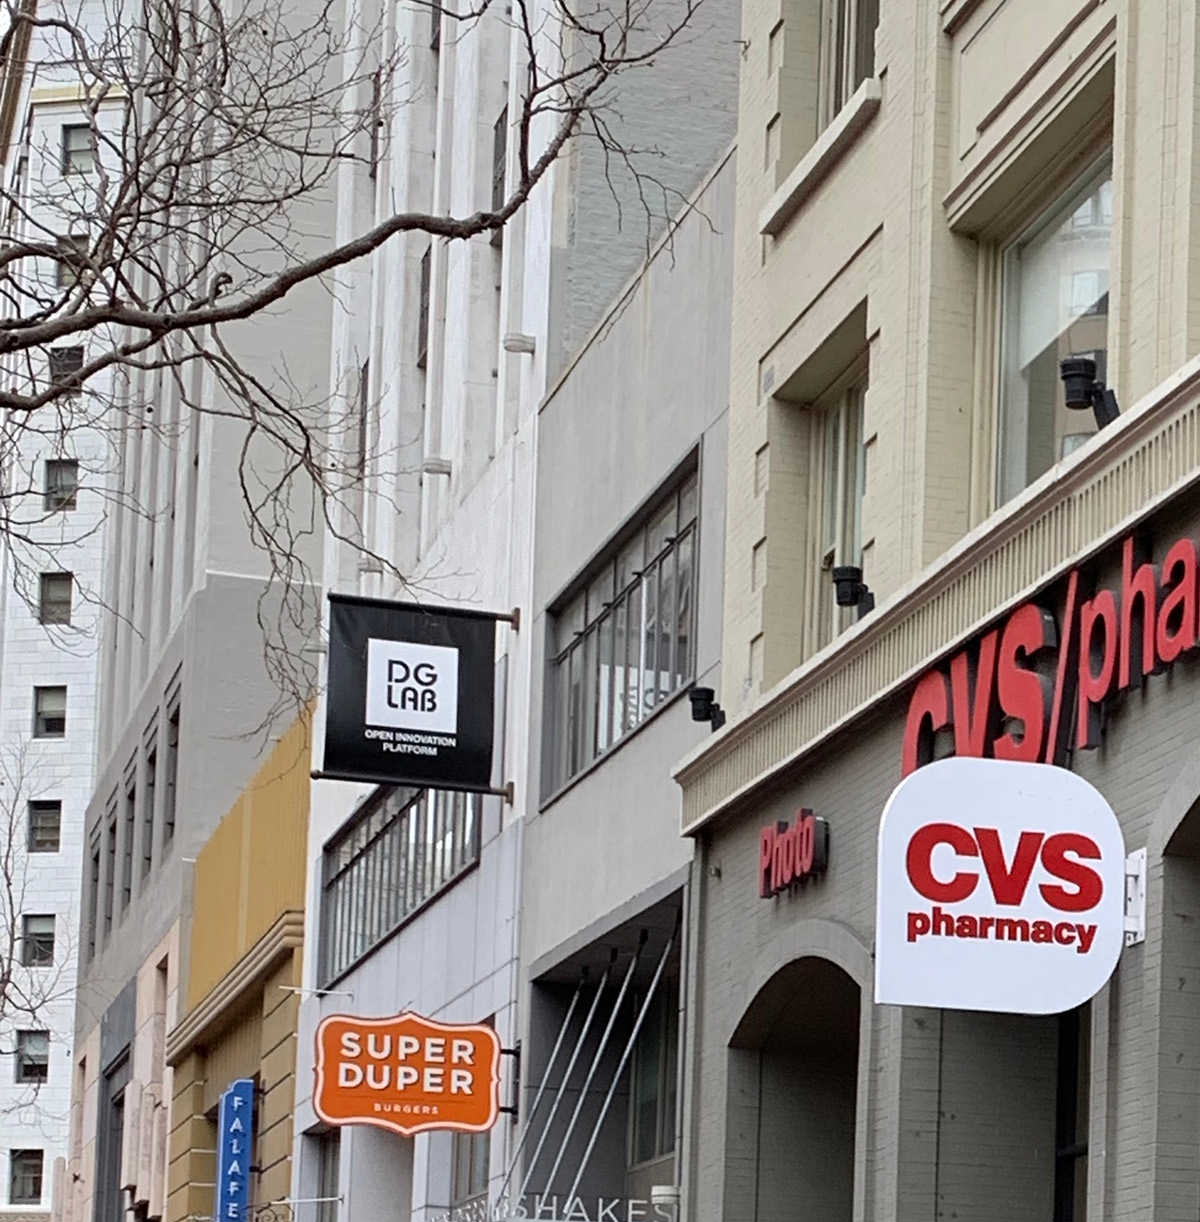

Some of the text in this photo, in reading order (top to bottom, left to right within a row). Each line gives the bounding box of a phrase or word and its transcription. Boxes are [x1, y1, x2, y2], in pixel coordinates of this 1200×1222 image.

[387, 659, 438, 686] DG
[387, 684, 438, 712] LAB
[364, 729, 457, 747] OPEN INNOVATION
[383, 743, 438, 756] PLATFORM
[759, 808, 817, 899] Photo
[905, 822, 1104, 913] CVS
[906, 906, 1098, 954] pharmacy
[340, 1031, 475, 1065] SUPER
[338, 1062, 474, 1095] DUPER
[373, 1103, 439, 1115] BURGERS
